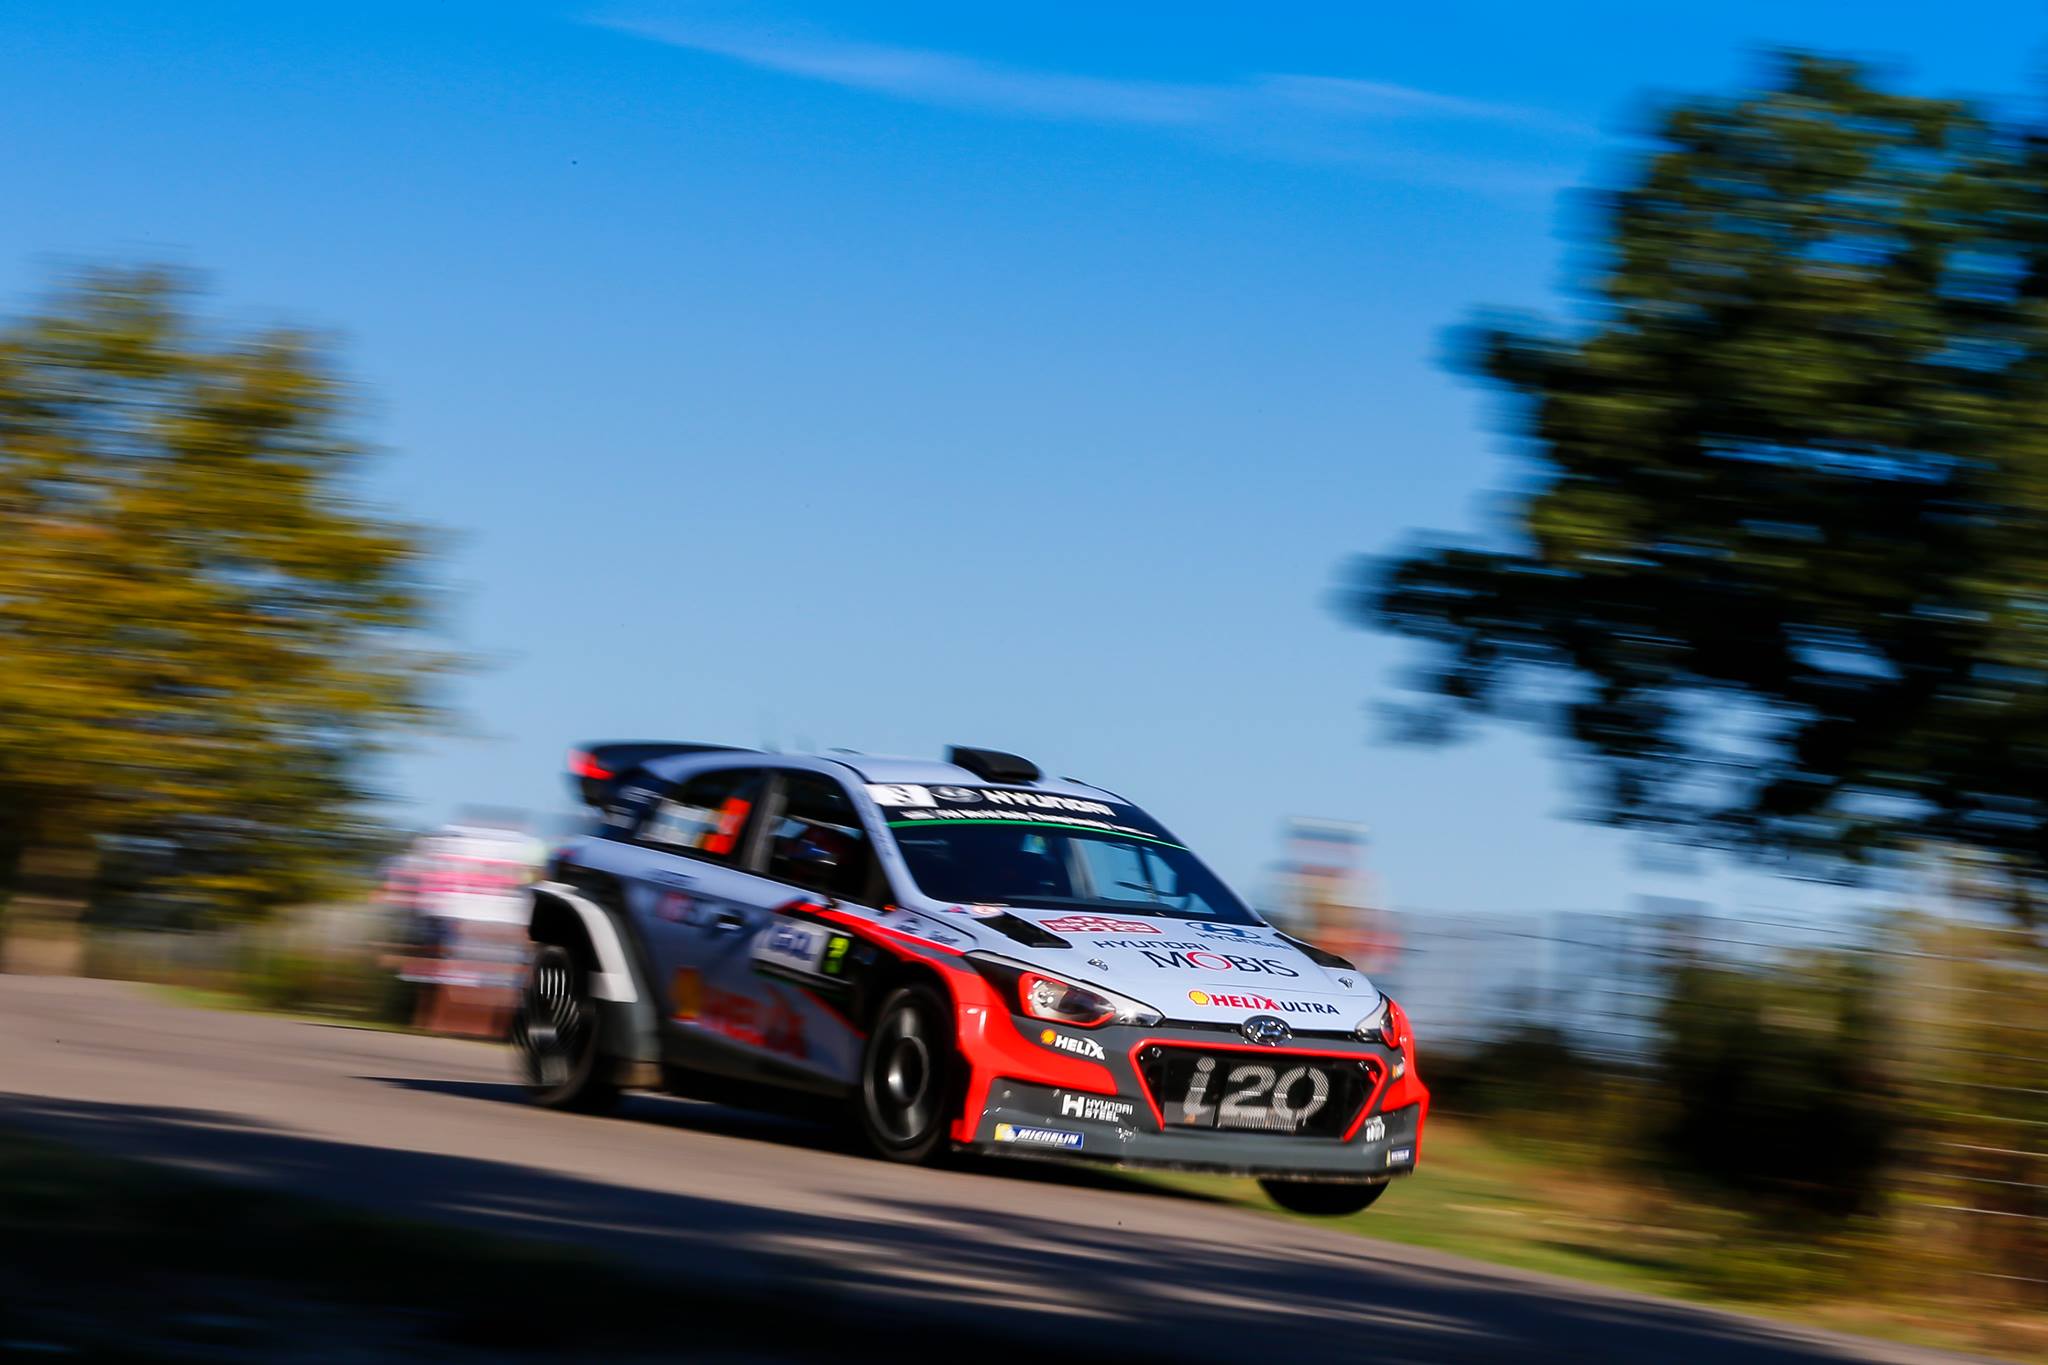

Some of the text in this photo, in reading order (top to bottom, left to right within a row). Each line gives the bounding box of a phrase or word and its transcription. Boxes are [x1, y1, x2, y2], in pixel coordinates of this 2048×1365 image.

[1092, 940, 1212, 951] HYUNDAI
[1140, 951, 1299, 977] MOBIS
[1210, 992, 1340, 1015] HELIX ULTRA
[1055, 1035, 1105, 1060] HELIX
[1183, 1056, 1329, 1125] i20
[1084, 1109, 1119, 1122] STEEL
[1086, 1098, 1133, 1115] HYUNDAI
[1015, 1128, 1079, 1145] MICHELIN
